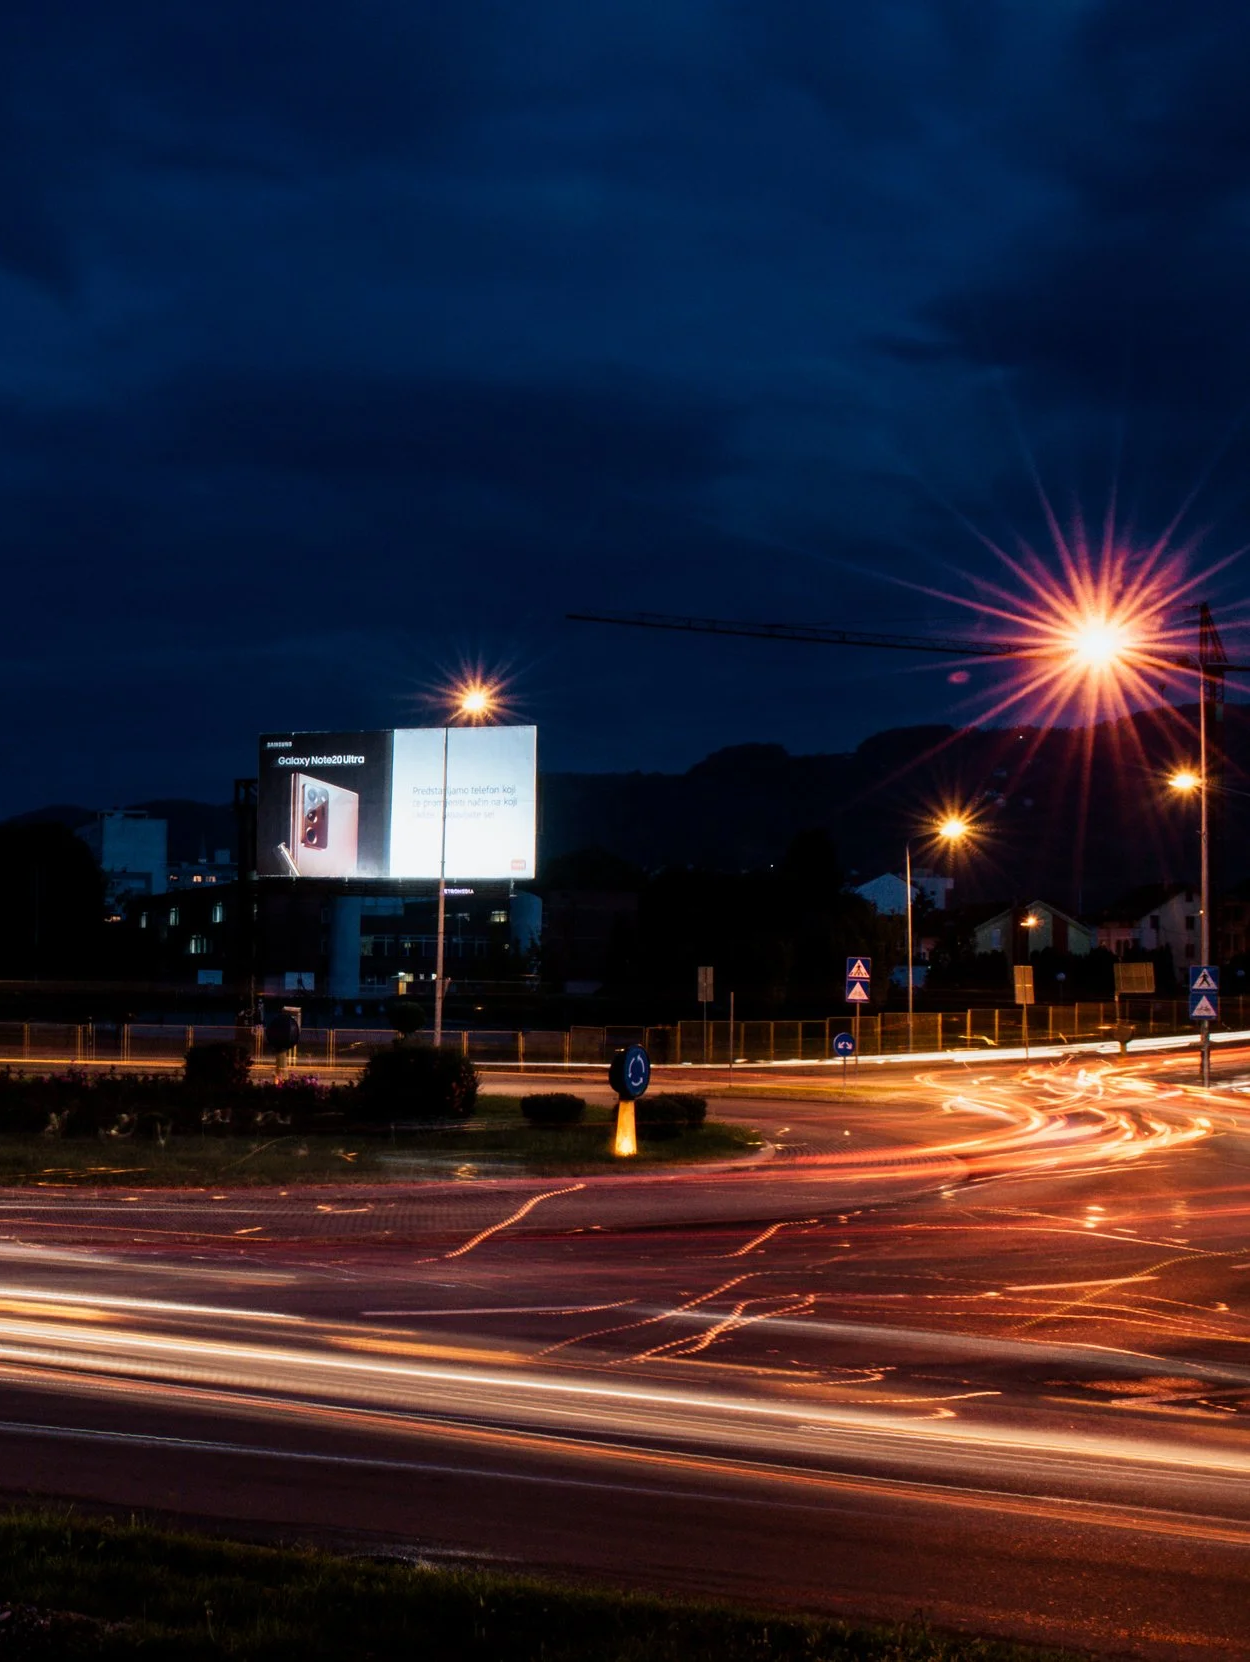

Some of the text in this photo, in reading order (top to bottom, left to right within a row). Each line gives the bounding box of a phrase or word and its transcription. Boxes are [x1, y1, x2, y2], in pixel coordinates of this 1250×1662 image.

[278, 754, 365, 767] Galaxy Note20 Ultra
[471, 785, 500, 795] telefon
[502, 784, 516, 795] koji
[503, 797, 518, 808] koji
